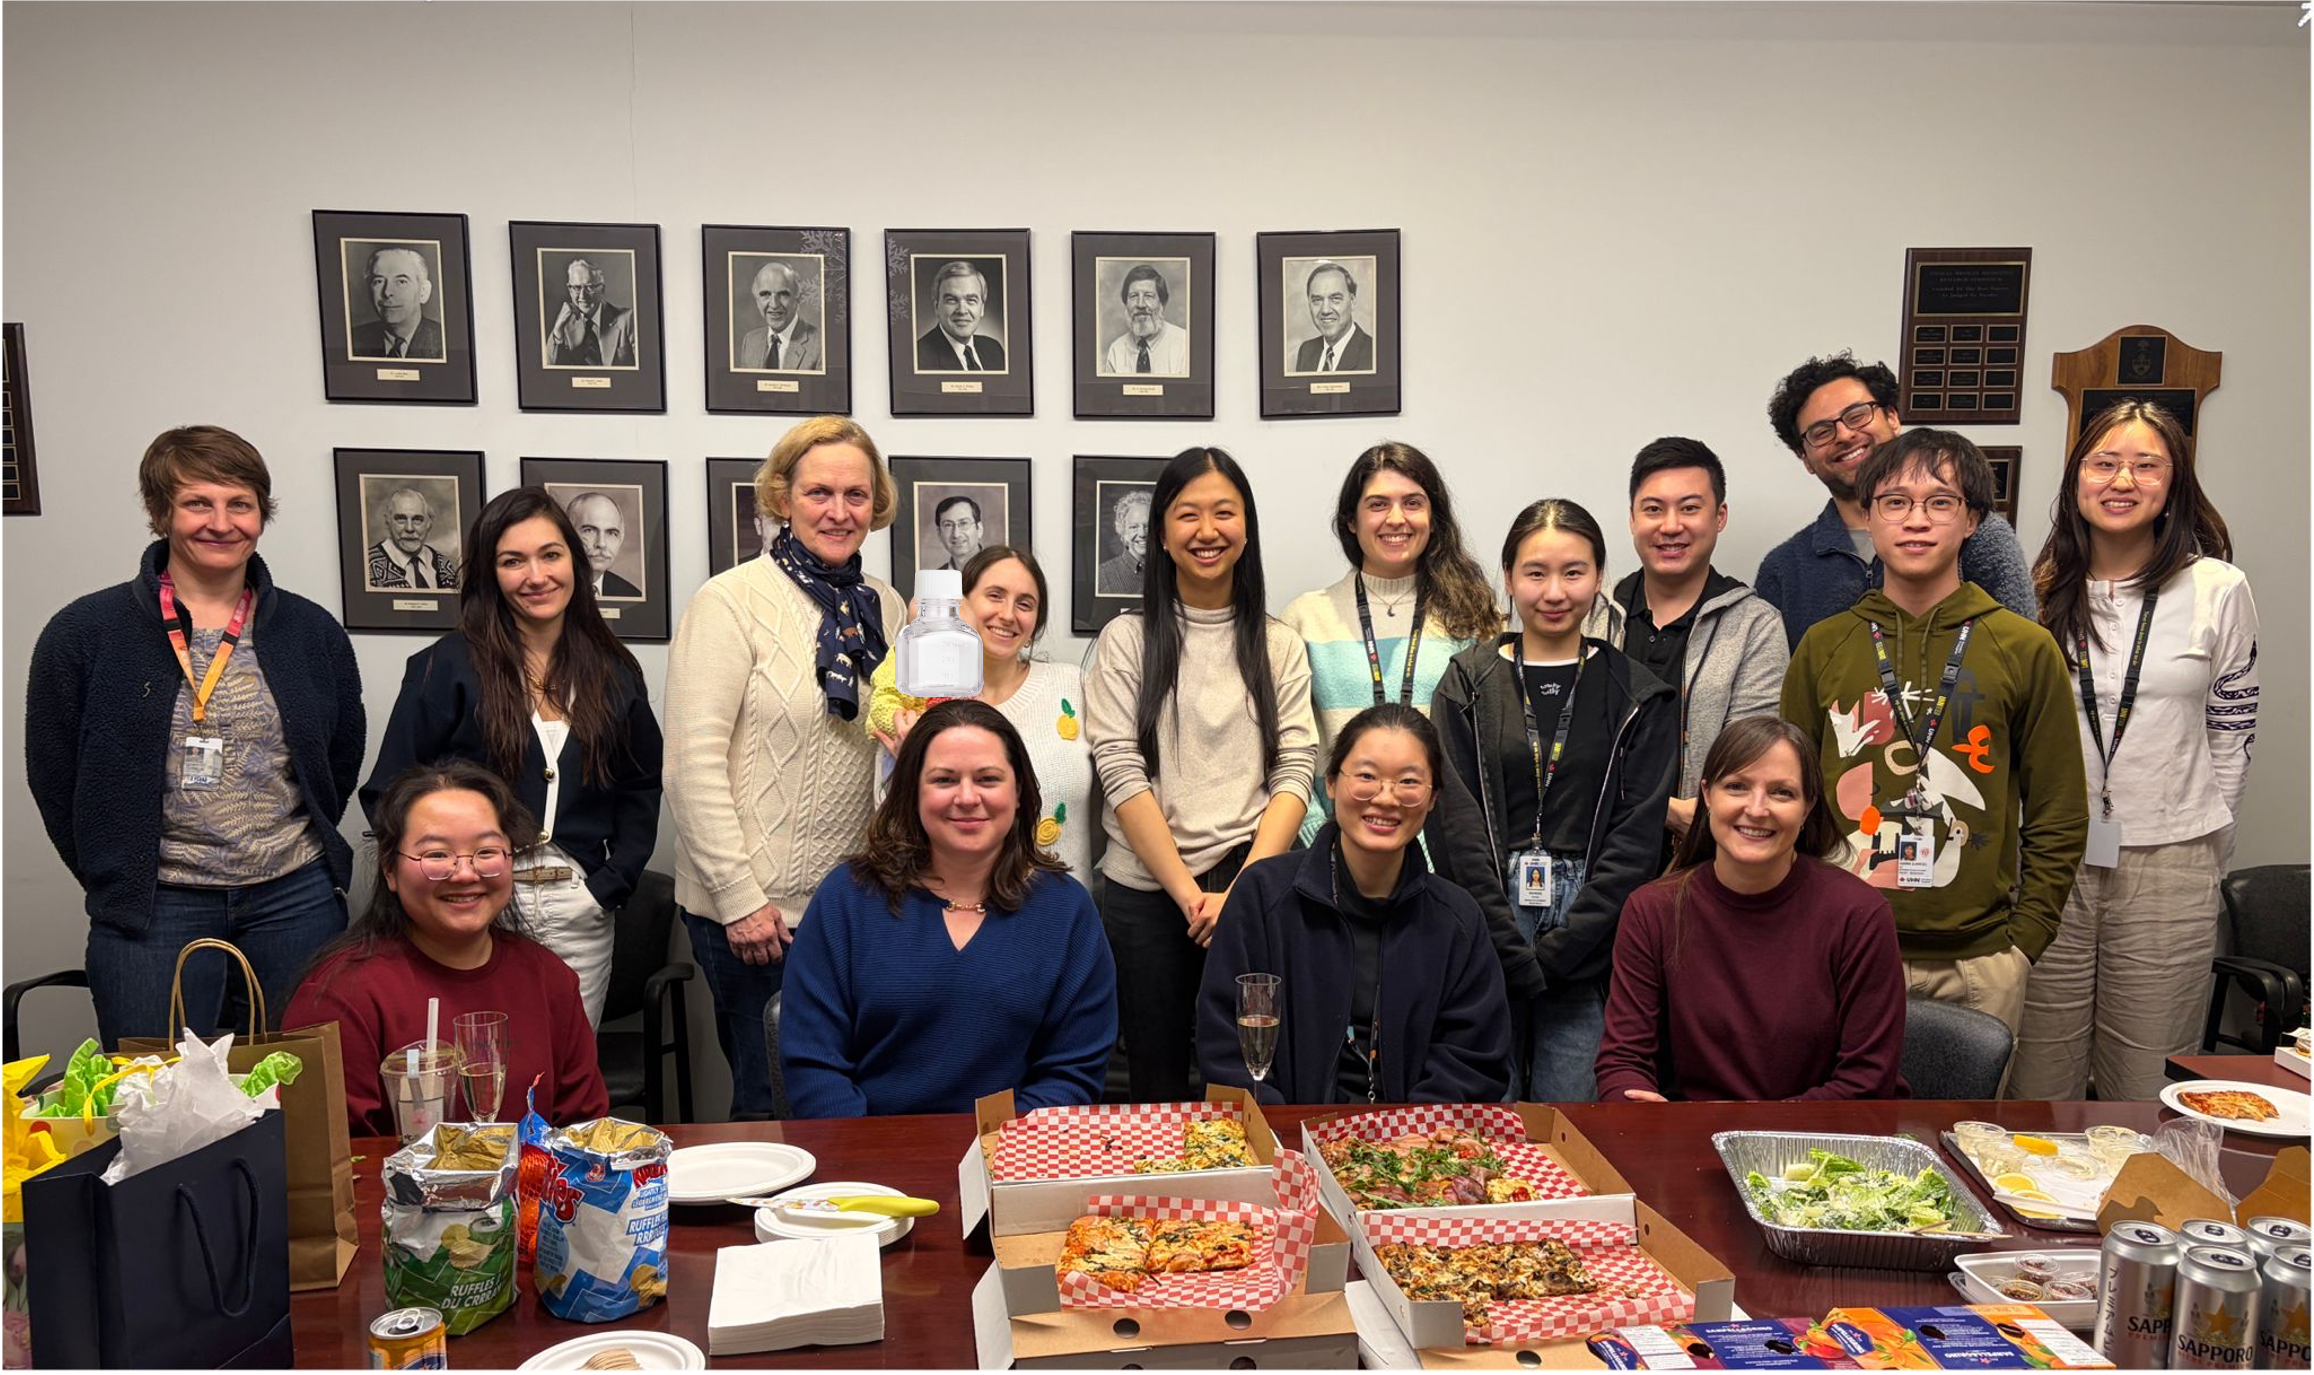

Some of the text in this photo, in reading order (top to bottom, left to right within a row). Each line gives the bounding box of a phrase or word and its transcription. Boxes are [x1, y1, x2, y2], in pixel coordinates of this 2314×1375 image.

[451, 1277, 495, 1297] RUFFLES
[441, 1298, 462, 1309] DU
[2178, 1335, 2253, 1363] SAPPORO
